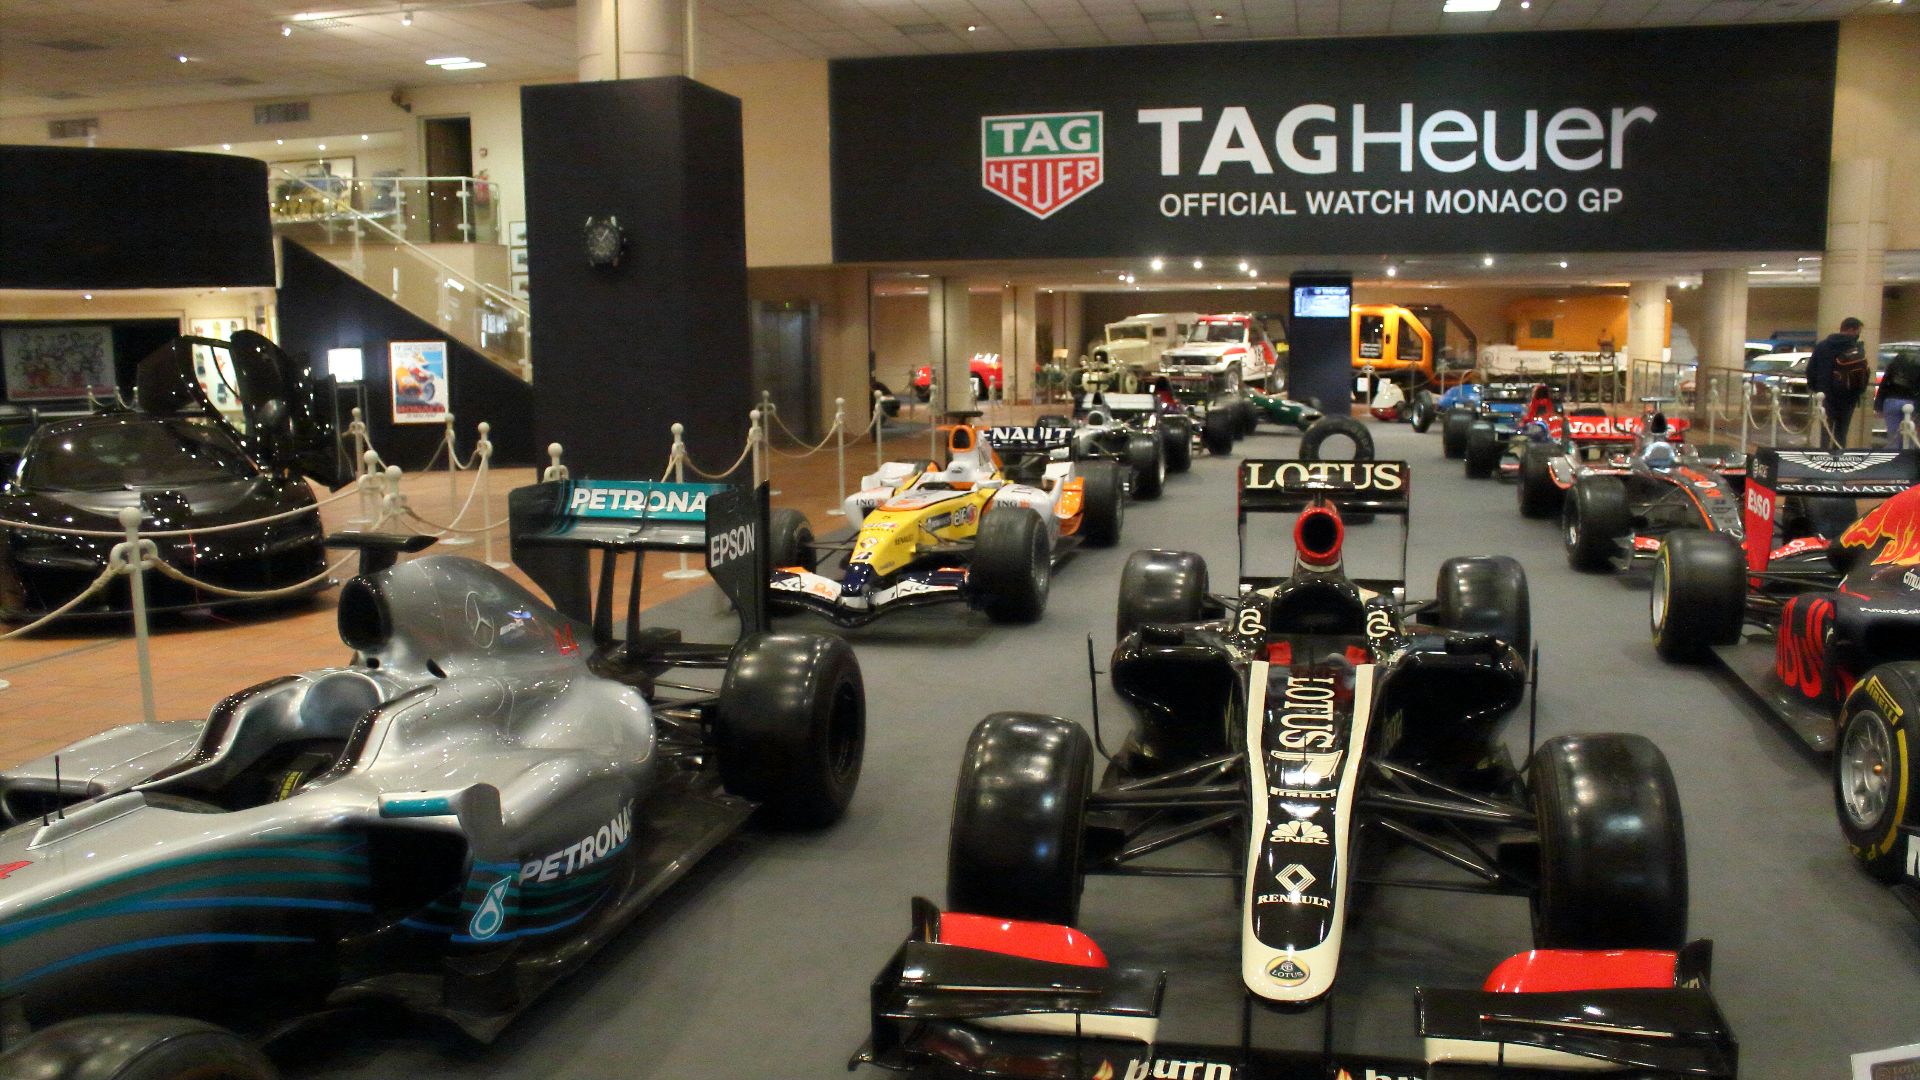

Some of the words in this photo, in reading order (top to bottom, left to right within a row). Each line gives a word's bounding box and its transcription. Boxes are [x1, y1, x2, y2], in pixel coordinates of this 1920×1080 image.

[992, 119, 1091, 153] TAG
[989, 160, 1096, 211] HEUER
[1160, 192, 1296, 217] OFFICIAL
[1306, 190, 1414, 214] WATCH
[1426, 188, 1567, 213] MONACO
[1578, 188, 1623, 213] GP
[1246, 463, 1402, 490] LOTUS
[1842, 485, 1911, 493] MARTI
[710, 522, 755, 568] EPSON
[1279, 677, 1336, 748] LOTUS
[1270, 836, 1330, 845] CNBC
[1271, 969, 1304, 978] LOTUS
